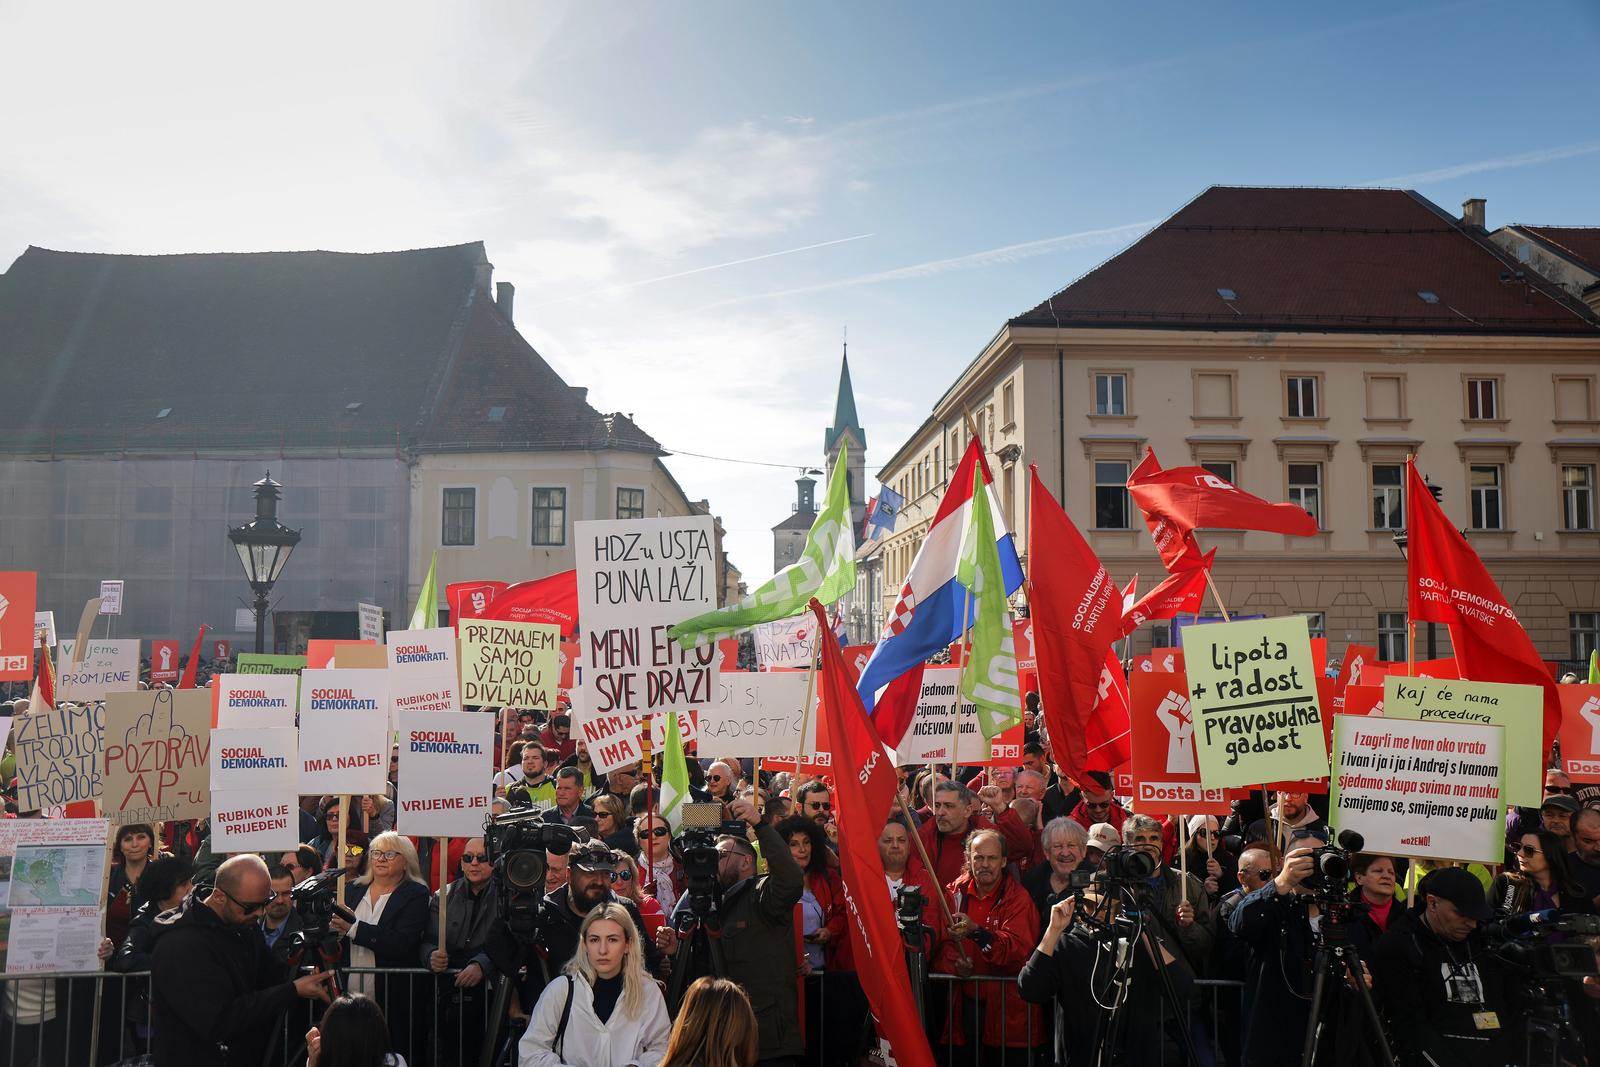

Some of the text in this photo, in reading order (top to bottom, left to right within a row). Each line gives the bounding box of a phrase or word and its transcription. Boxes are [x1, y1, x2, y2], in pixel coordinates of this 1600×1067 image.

[659, 529, 712, 561] USTA
[595, 568, 654, 604] PUNA
[658, 560, 709, 604] LAŽI,
[1457, 603, 1495, 626] RVATSKE
[465, 625, 555, 650] PRIZNAJEM
[395, 645, 429, 655] SOCIJAL
[396, 652, 448, 663] DEMOKRATI.
[480, 646, 533, 667] SAMO
[590, 627, 641, 669] MENI
[757, 640, 814, 662] HRVATSK
[1212, 636, 1288, 675] lipota
[62, 671, 131, 686] PROMJENE
[473, 663, 541, 686] VLADU
[1216, 666, 1303, 699] radost
[229, 690, 267, 699] SOCIJAL
[311, 688, 355, 699] SOCIJAL
[465, 682, 548, 708] DIVLJANA
[595, 673, 638, 713] SVE
[646, 662, 711, 709] DRAŽI
[921, 683, 955, 699] jednom
[1437, 685, 1453, 700] će
[1464, 694, 1499, 705] nama
[229, 698, 287, 707] DEMOKRATI.
[311, 699, 378, 710] DEMOKRATI.
[396, 690, 452, 706] RUBIKON JE
[950, 701, 977, 717] dugo
[1420, 708, 1492, 724] procedura
[1205, 703, 1321, 745] pravosudna
[410, 731, 457, 743] SOCIJAL
[1225, 728, 1302, 766] gadost
[1354, 731, 1486, 755] I zagrli me Ivan oko vrata
[104, 735, 210, 776] POZDRAV
[221, 747, 265, 758] SOCIJAL
[410, 742, 483, 754] DEMOKRATI.
[599, 739, 635, 767] IMA
[221, 757, 288, 769] DEMOKRATI.
[304, 753, 381, 772] IMA NADE!
[1347, 752, 1370, 767] Ivan
[1376, 754, 1387, 771] ja
[1395, 756, 1406, 773] ja
[1413, 757, 1450, 776] Andrej
[1450, 762, 1456, 774] s
[1459, 759, 1498, 777] Ivanom
[119, 770, 203, 811] AP-u
[1142, 784, 1194, 799] Dosta
[1338, 773, 1499, 799] sjedamo skupa svima na muku
[218, 804, 289, 823] RUBIKON JE
[402, 796, 488, 812] VRIJEME JE!
[1338, 794, 1498, 822] i smijemo se, smijemo se puku
[225, 818, 287, 835] PRIJEĐEN!
